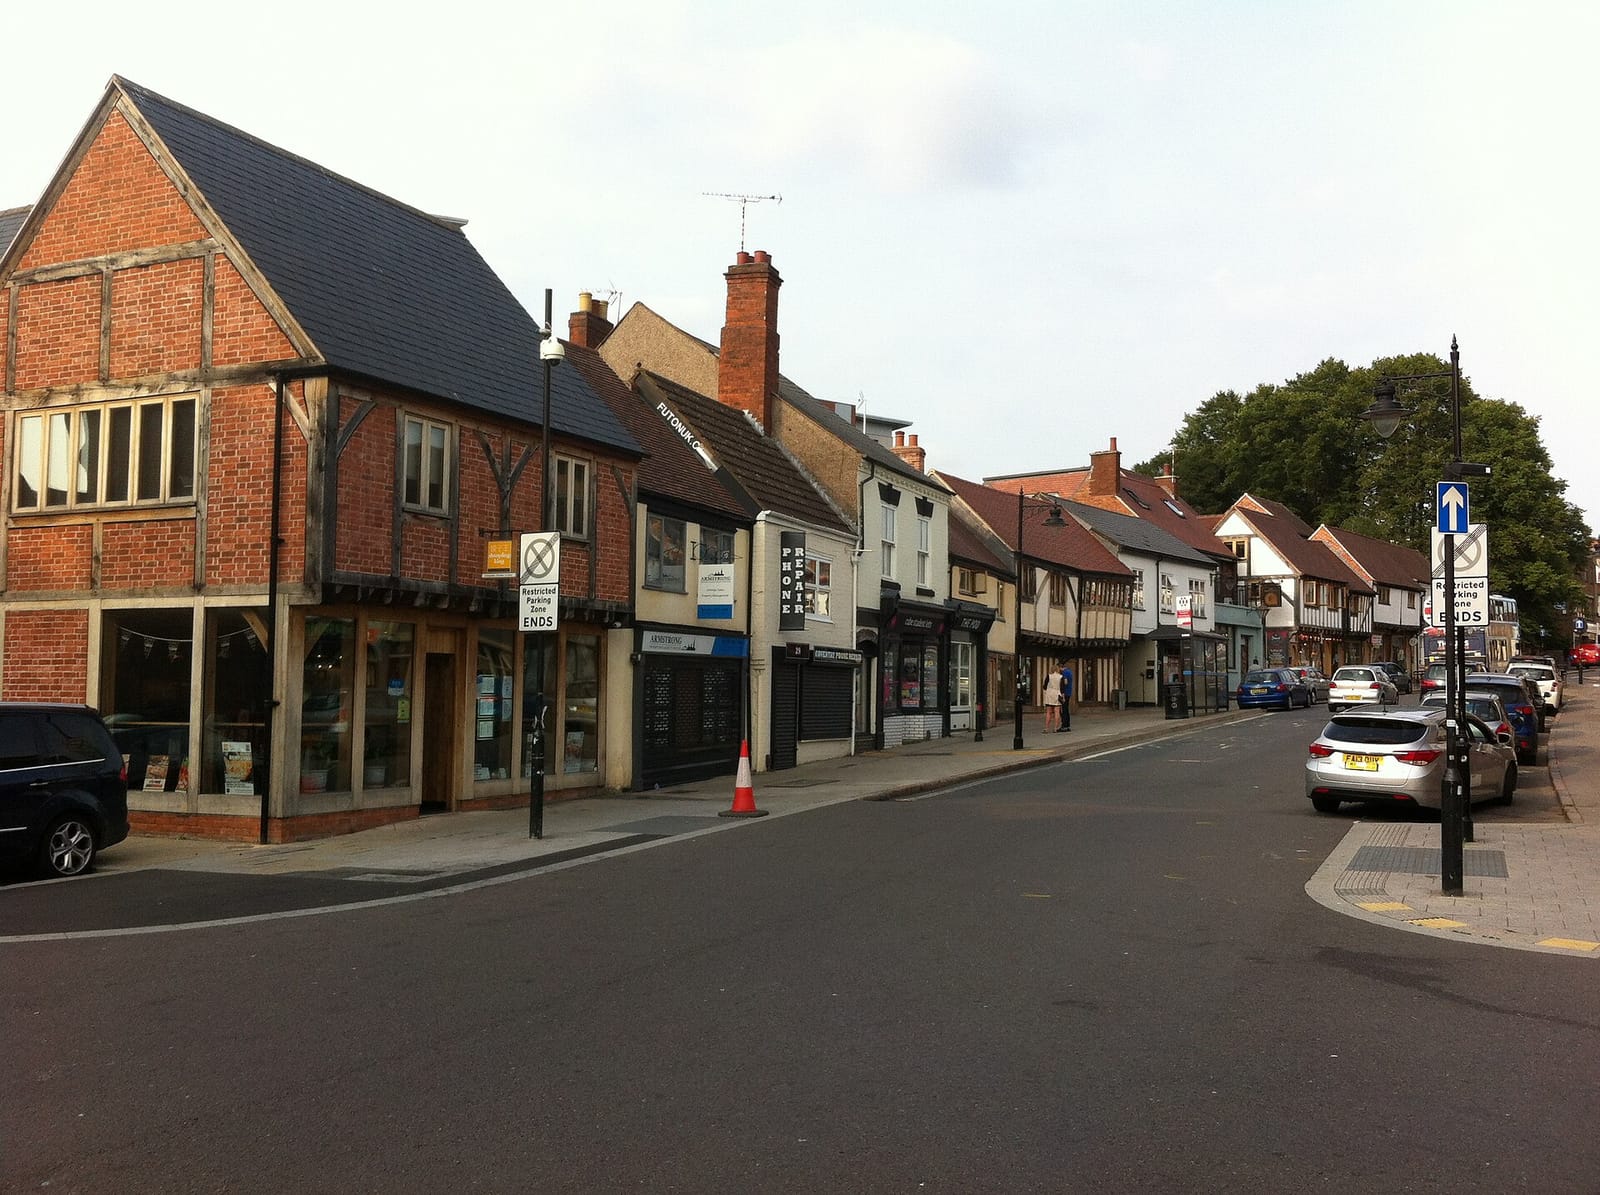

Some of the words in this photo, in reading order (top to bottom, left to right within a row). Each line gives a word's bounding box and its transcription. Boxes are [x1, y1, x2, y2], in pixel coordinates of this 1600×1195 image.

[782, 547, 791, 614] PHONE
[794, 547, 804, 614] REPAIR
[522, 587, 556, 595] Restricted
[526, 596, 551, 604] Parking
[530, 605, 547, 613] Zone
[523, 616, 553, 628] ENDS
